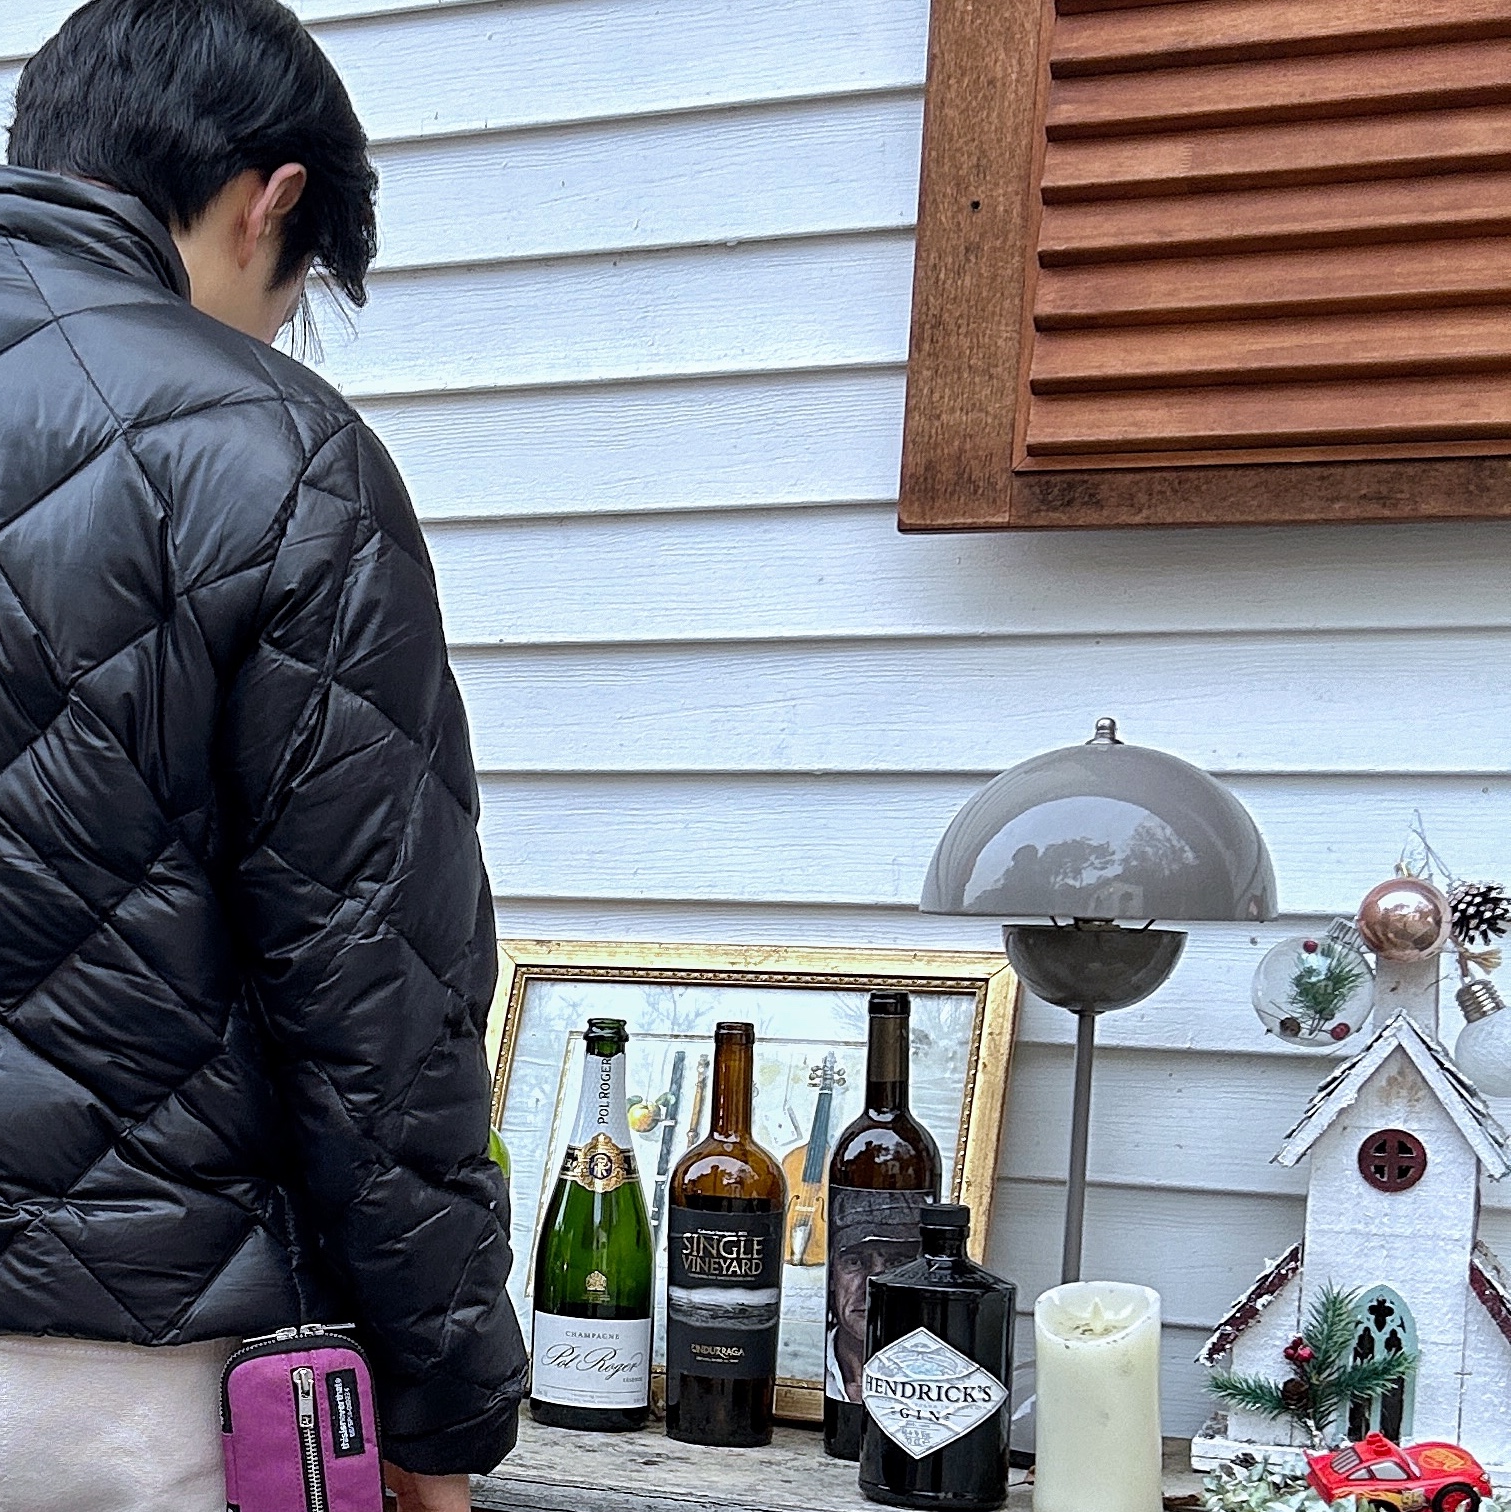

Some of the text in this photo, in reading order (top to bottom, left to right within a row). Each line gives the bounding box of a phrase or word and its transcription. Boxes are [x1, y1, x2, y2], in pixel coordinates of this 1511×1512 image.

[597, 1057, 612, 1125] POL ROGER
[682, 1232, 765, 1259] SINGLE
[681, 1254, 763, 1275] VINEYARD
[565, 1331, 620, 1340] CHAMPAGNE
[541, 1343, 644, 1380] Pol Roger
[865, 1373, 993, 1403] HENDRICK'S
[899, 1407, 941, 1422] GIN
